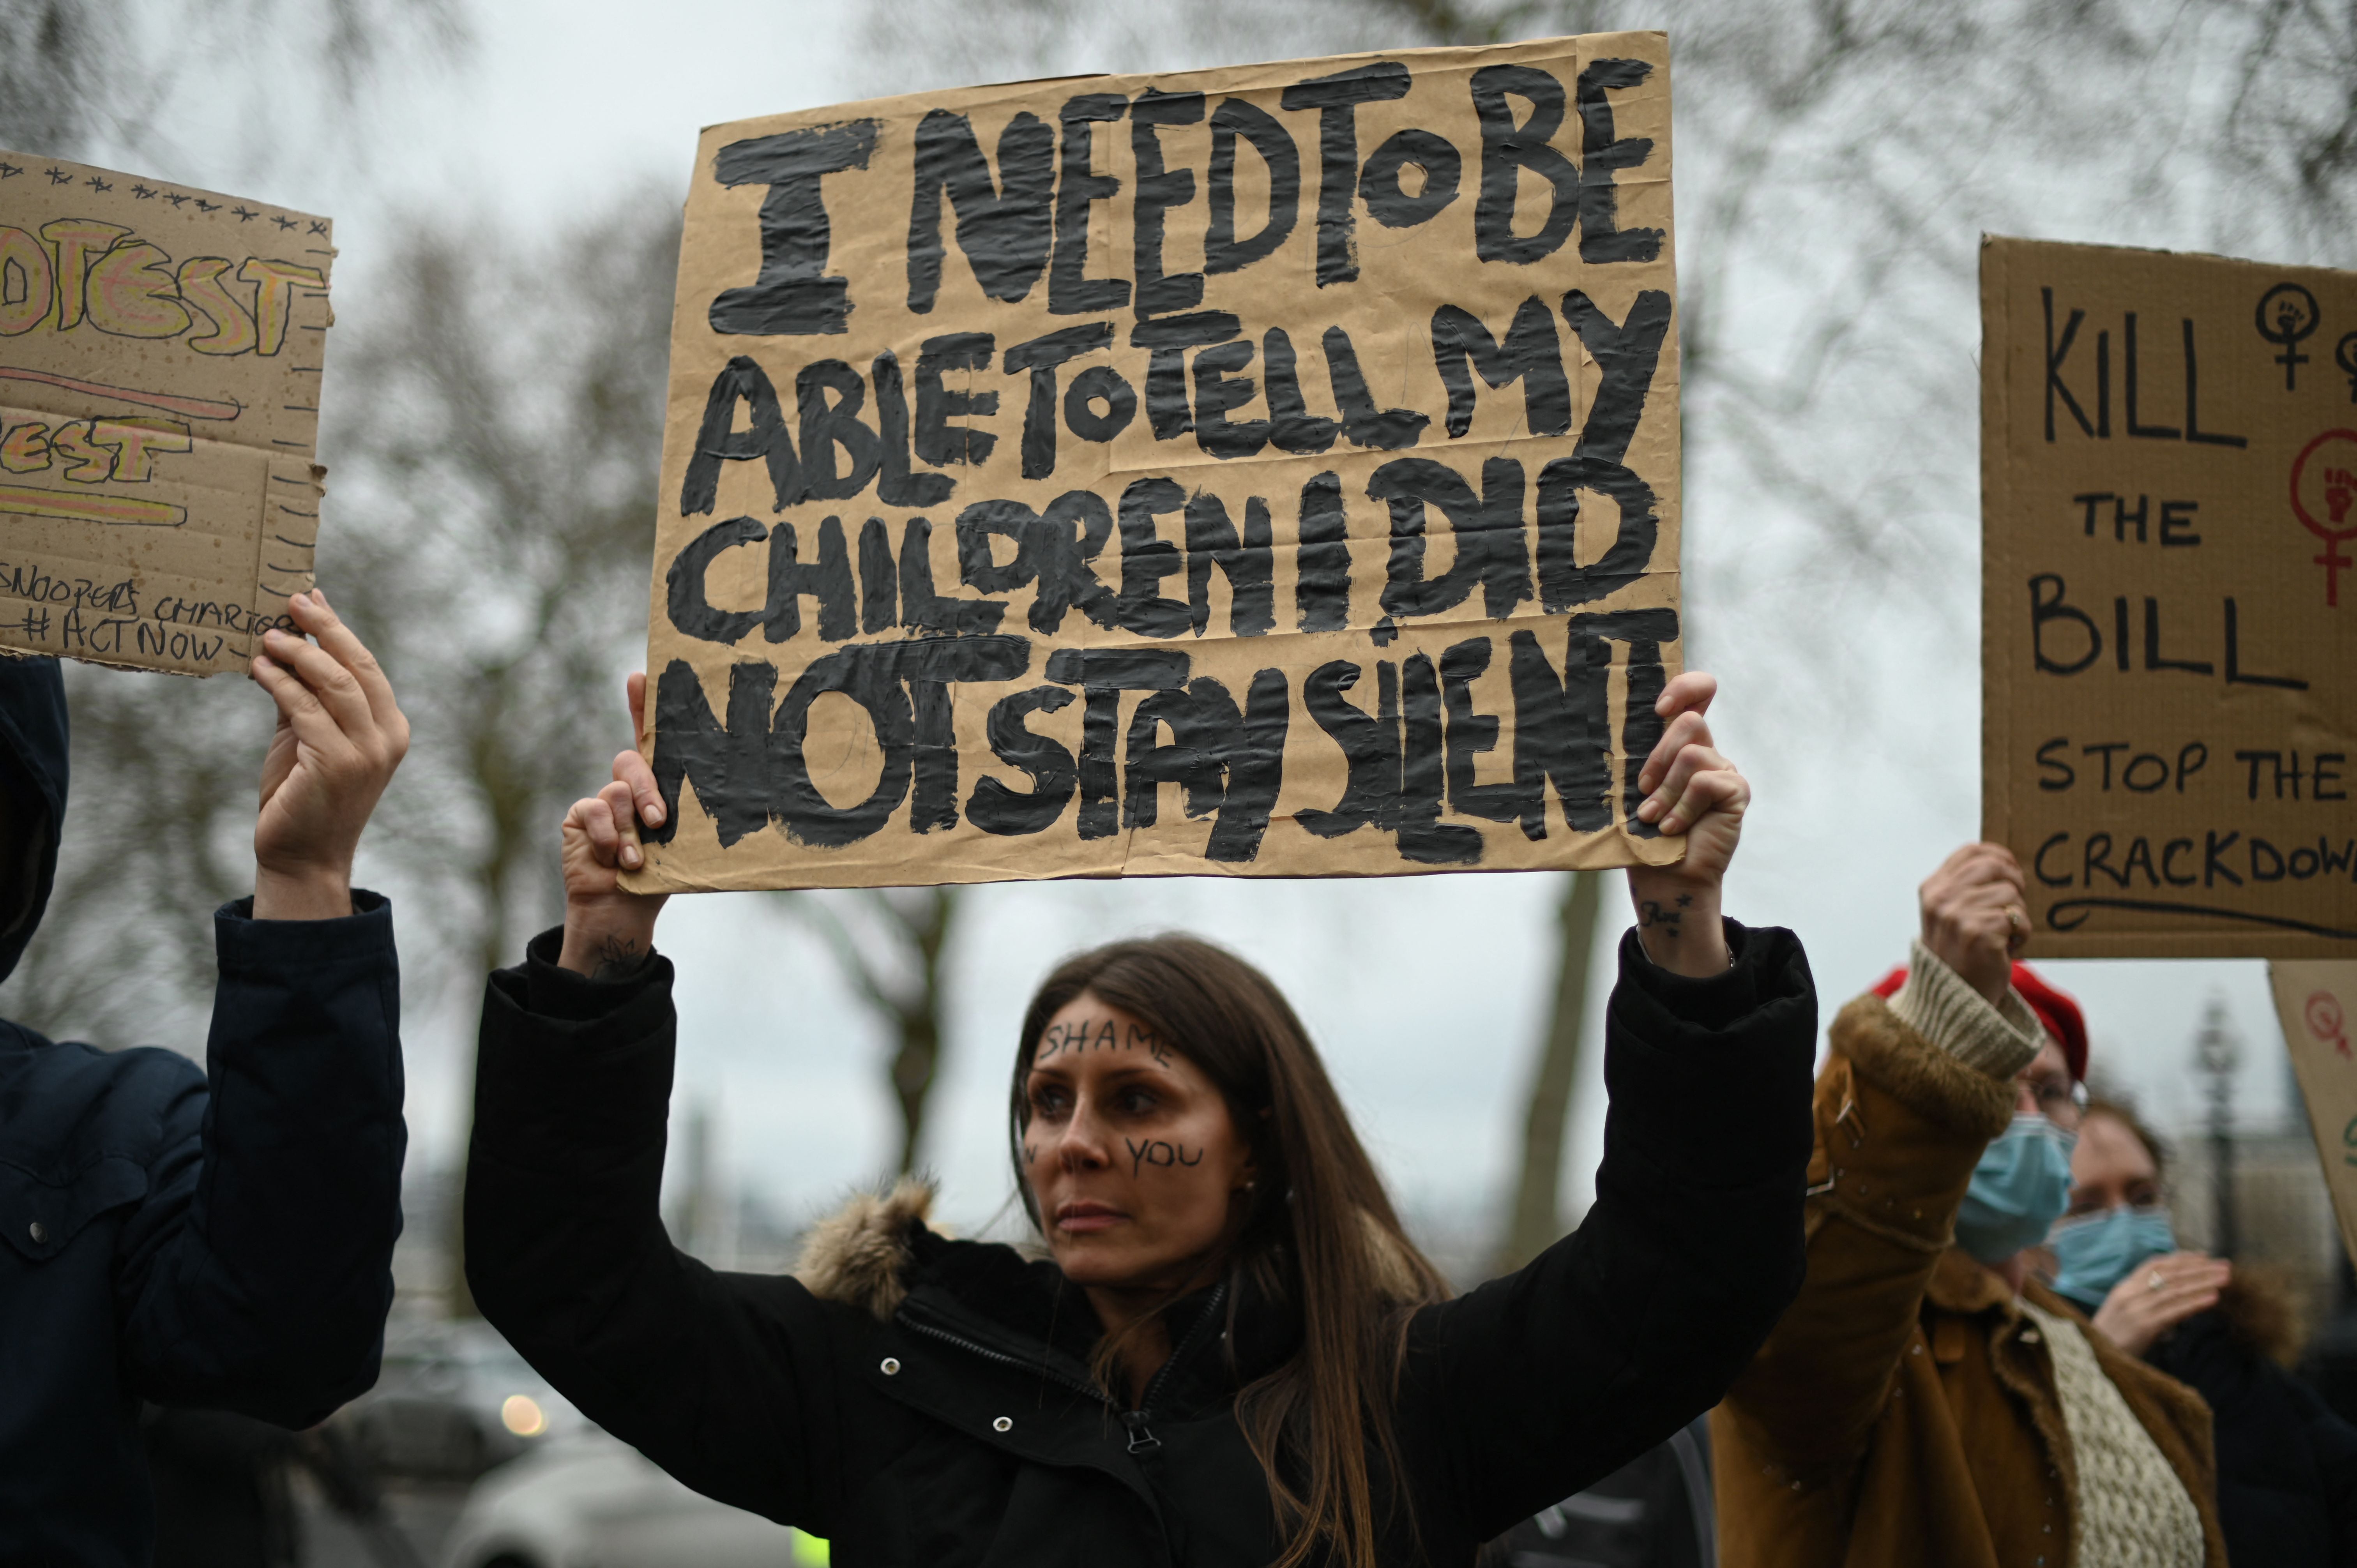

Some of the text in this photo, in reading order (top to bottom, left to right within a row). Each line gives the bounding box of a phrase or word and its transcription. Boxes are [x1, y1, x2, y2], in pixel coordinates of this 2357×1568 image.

[707, 57, 1667, 335] I NEED TO BE
[680, 290, 1671, 516] ABLE TO TELL MY
[2041, 287, 2248, 448] KILL
[0, 411, 192, 483] EST
[666, 457, 1659, 643] CHILDREN I DID
[2073, 492, 2202, 546] THE
[2028, 573, 2309, 691] BILL
[641, 609, 1679, 864] NOT STAY SILENT
[2036, 738, 2346, 801] STOP THE
[2034, 829, 2357, 888] CRACKDOW
[1040, 1019, 1173, 1068] SHAME
[1125, 1137, 1203, 1177] YOU
